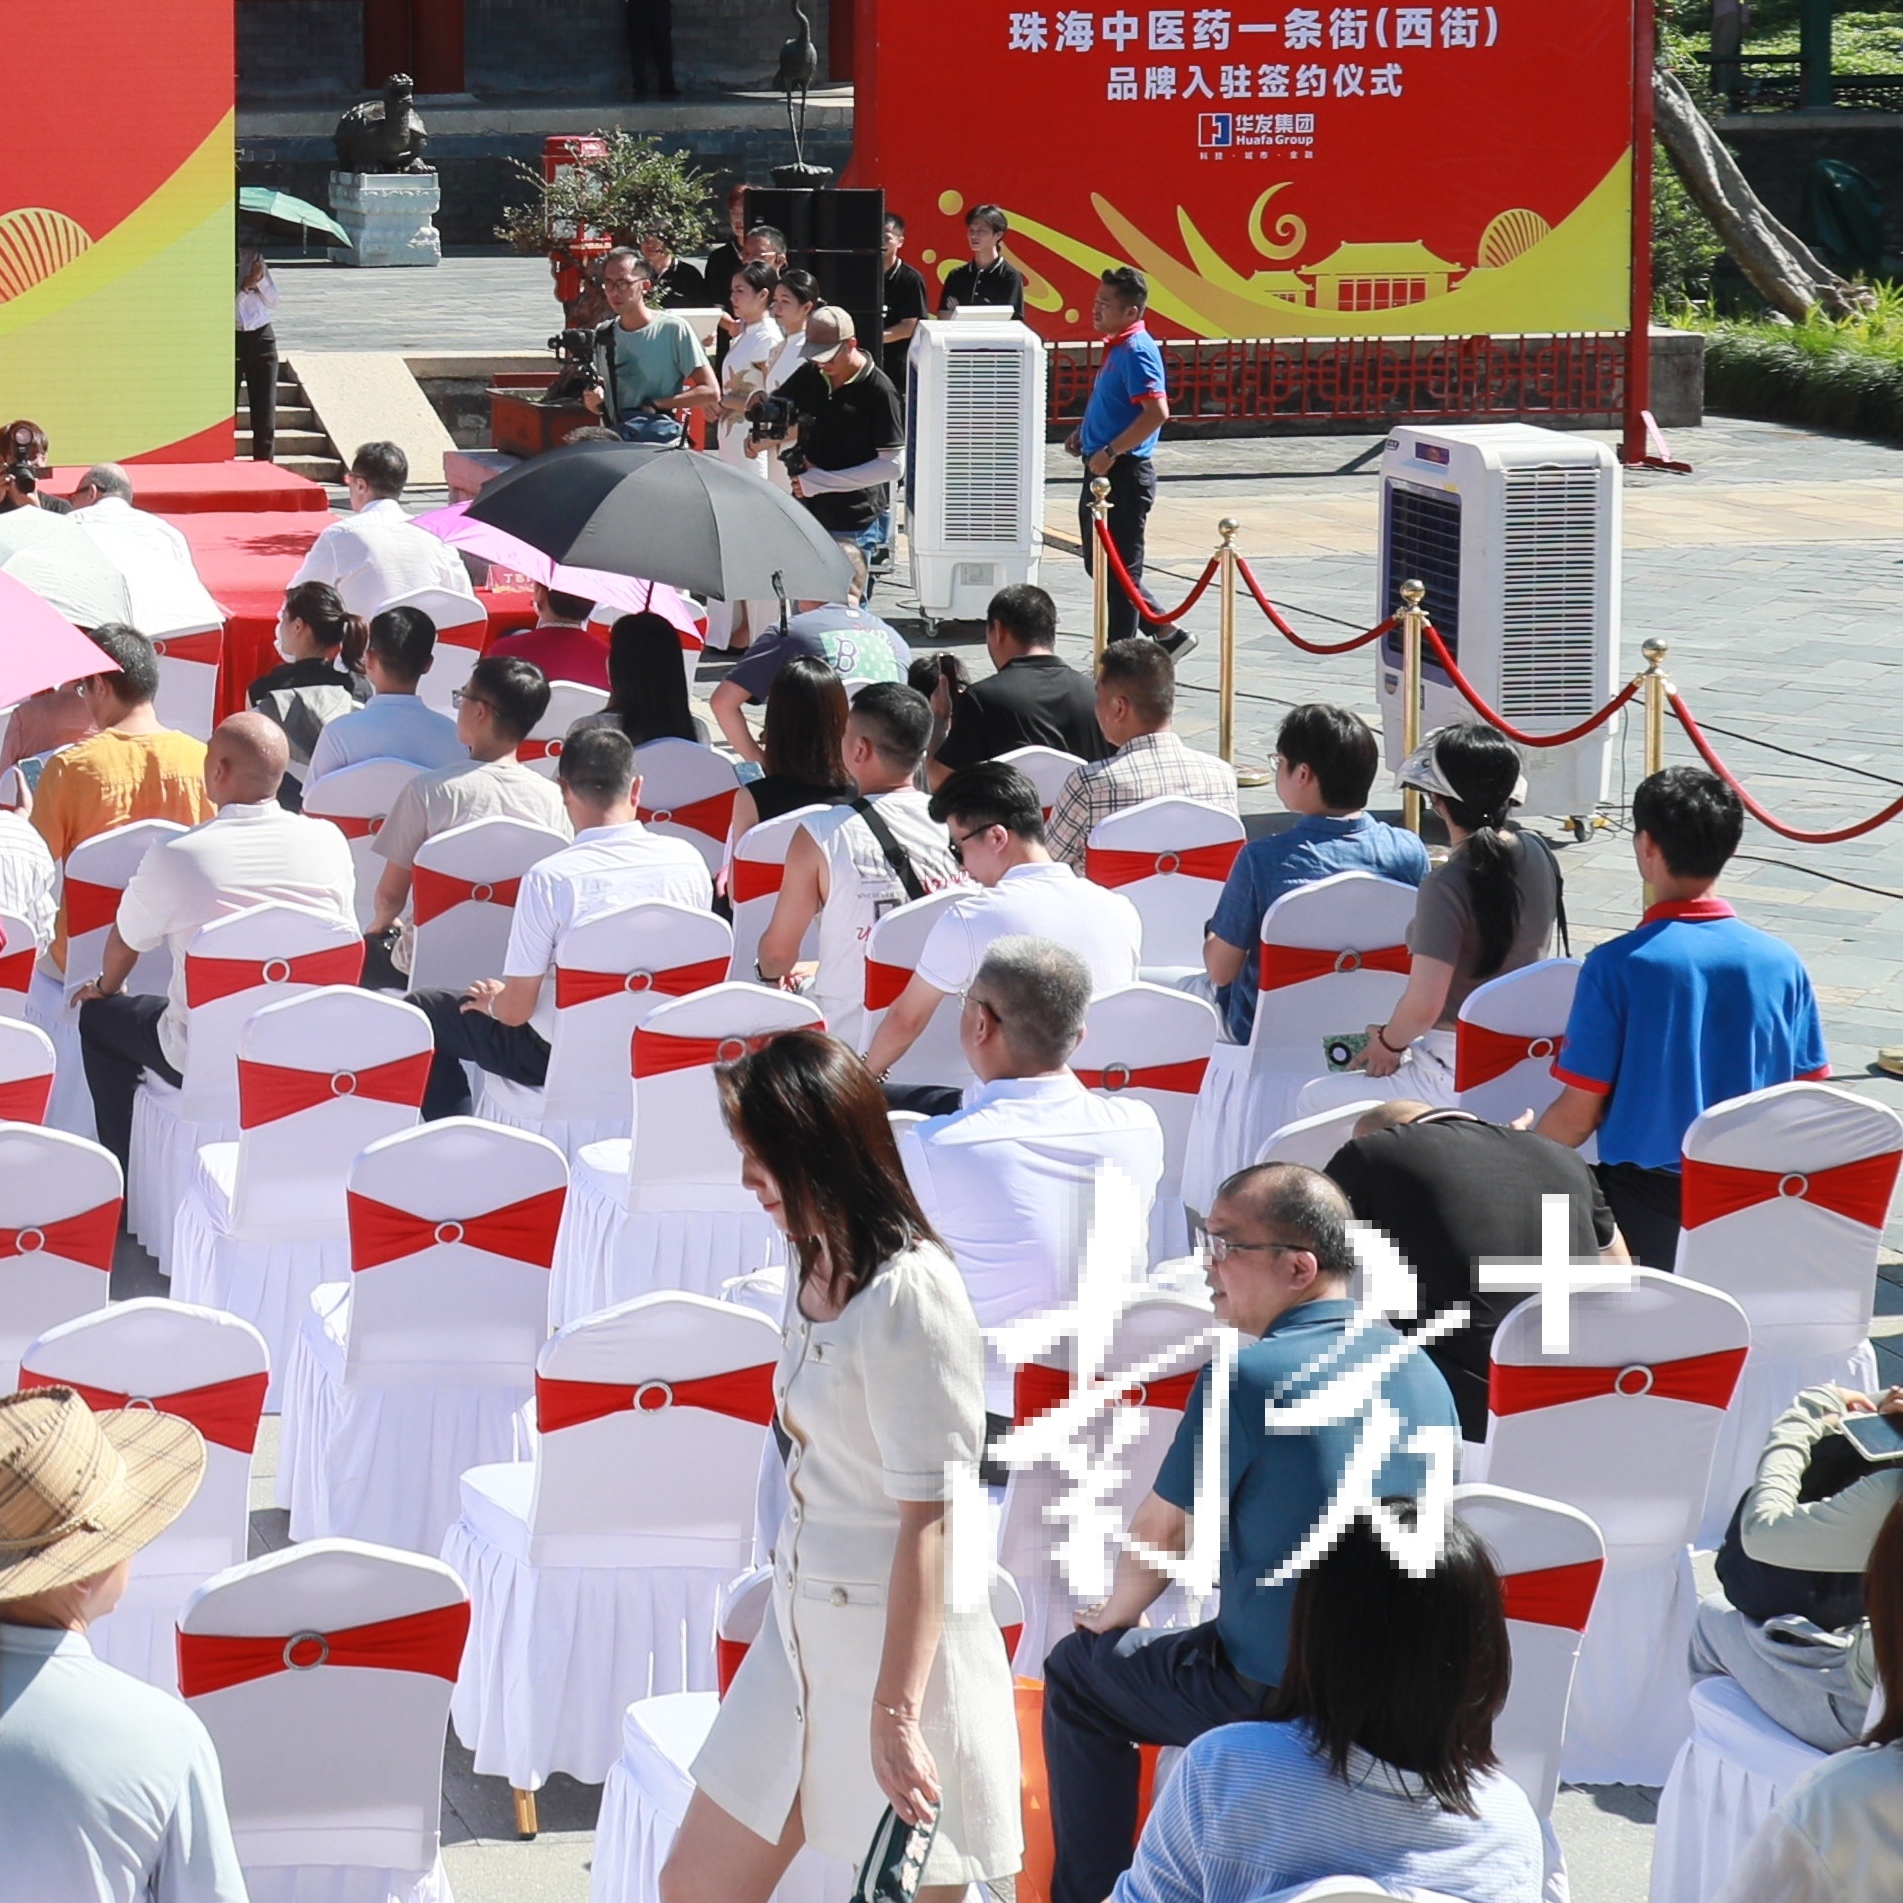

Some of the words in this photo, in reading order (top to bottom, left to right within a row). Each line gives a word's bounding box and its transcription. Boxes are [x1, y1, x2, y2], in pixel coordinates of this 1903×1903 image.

[1008, 6, 1498, 53] 珠海中医药一条街(西街)
[1107, 62, 1403, 101] 品牌入驻签约仪式
[1235, 113, 1314, 134] 华发集团
[1236, 135, 1274, 145] Huafa
[1275, 134, 1314, 147] Group
